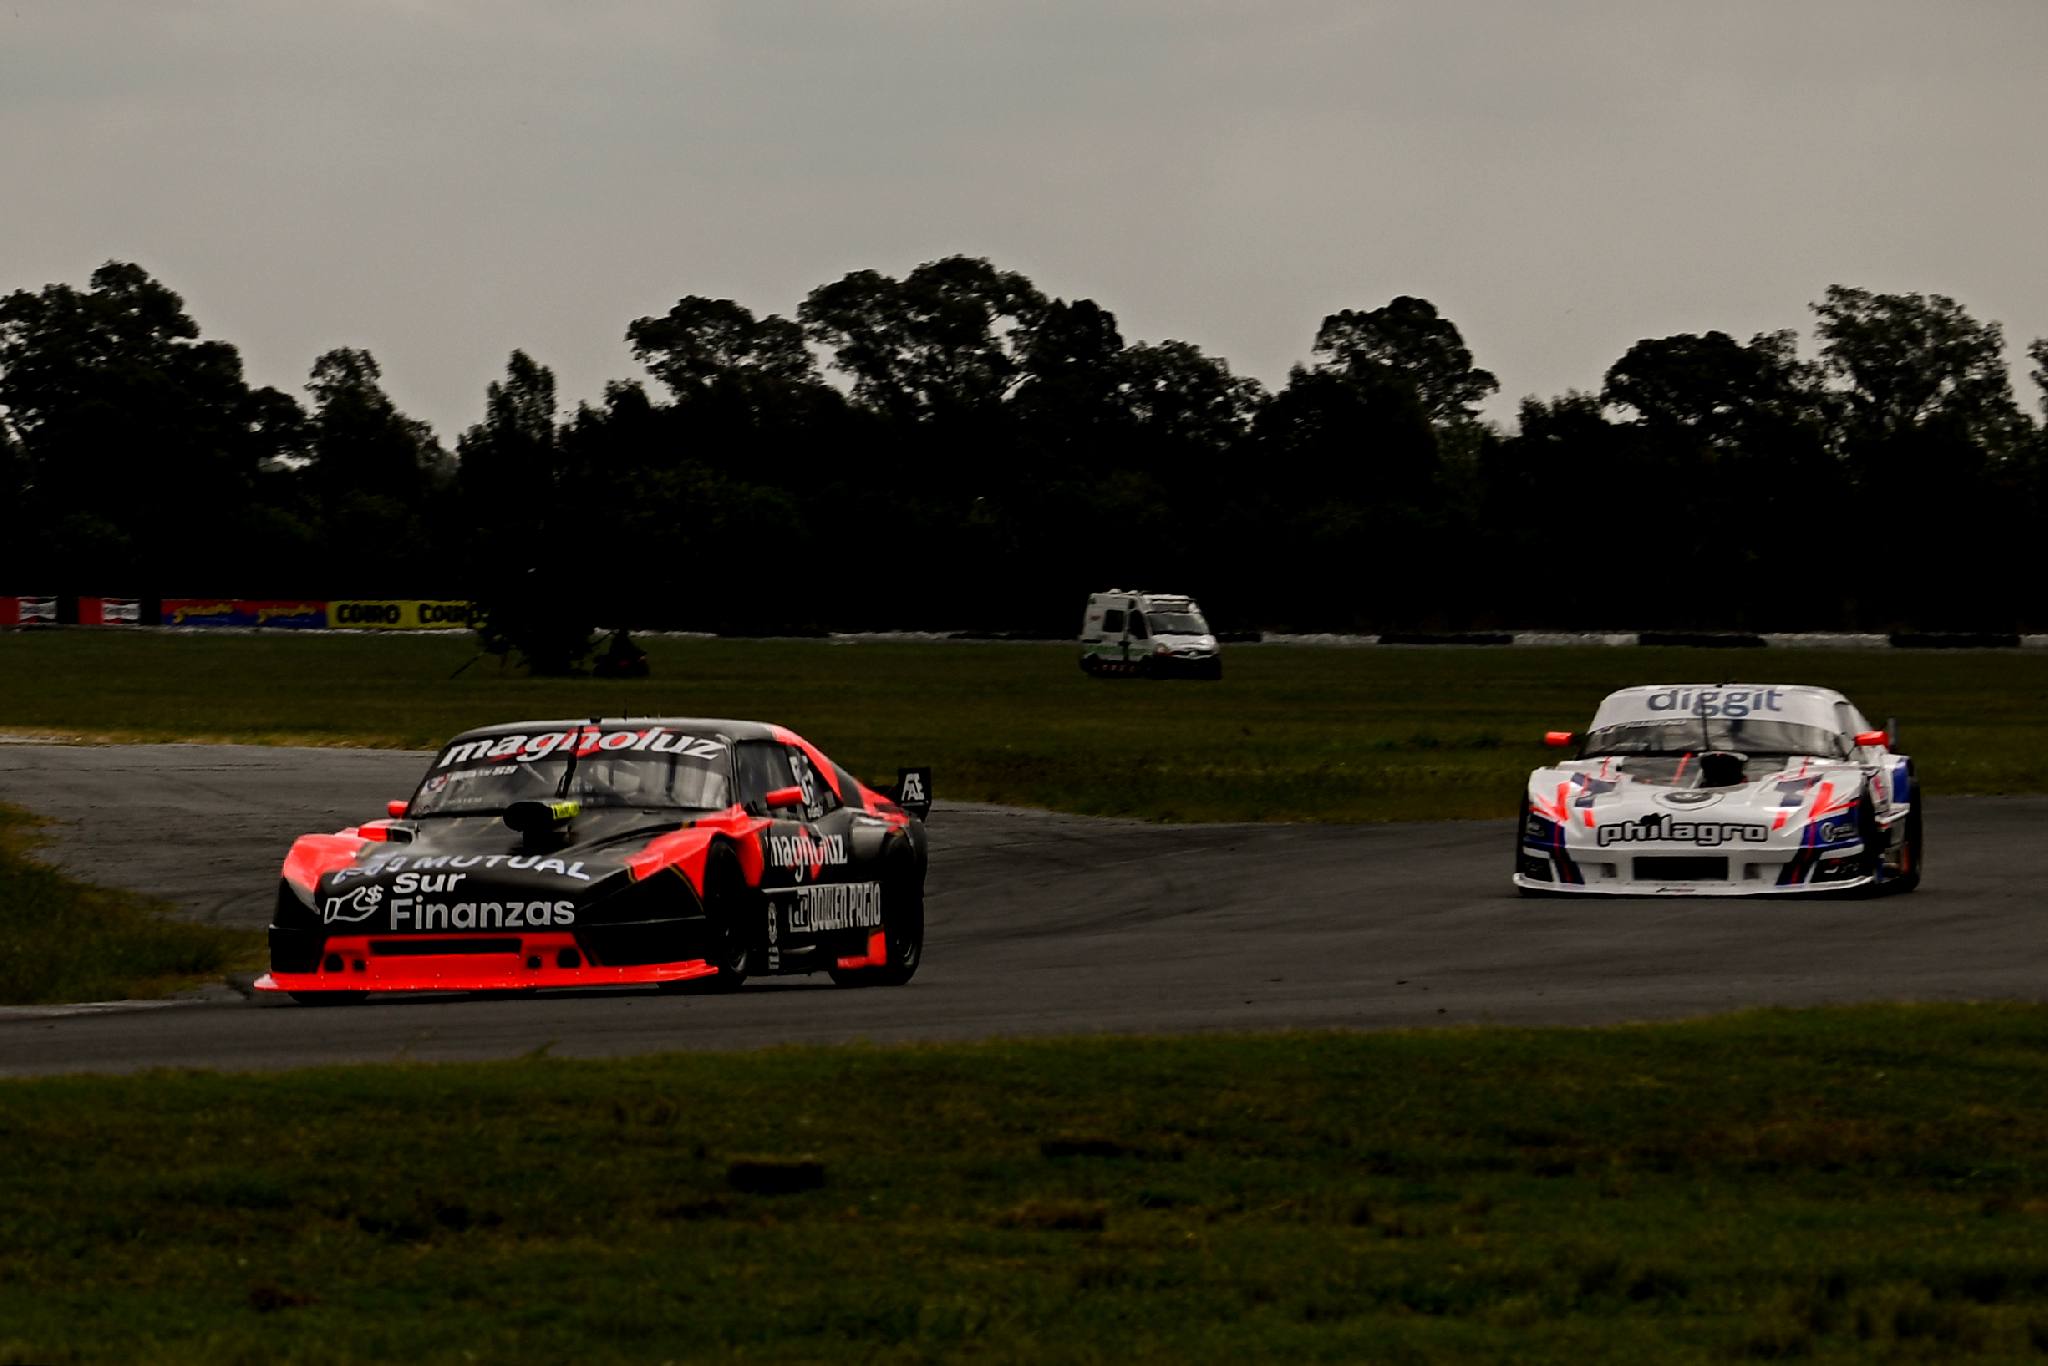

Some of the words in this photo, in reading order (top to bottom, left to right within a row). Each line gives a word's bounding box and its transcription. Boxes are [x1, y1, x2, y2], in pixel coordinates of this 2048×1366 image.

[1648, 690, 1784, 718] diggit
[438, 727, 728, 768] magnoluz
[1598, 814, 1768, 847] philagro
[392, 872, 467, 894] sur
[412, 855, 590, 880] MUTUAL
[390, 895, 576, 931] Finanzas
[849, 882, 880, 929] PAGIO
